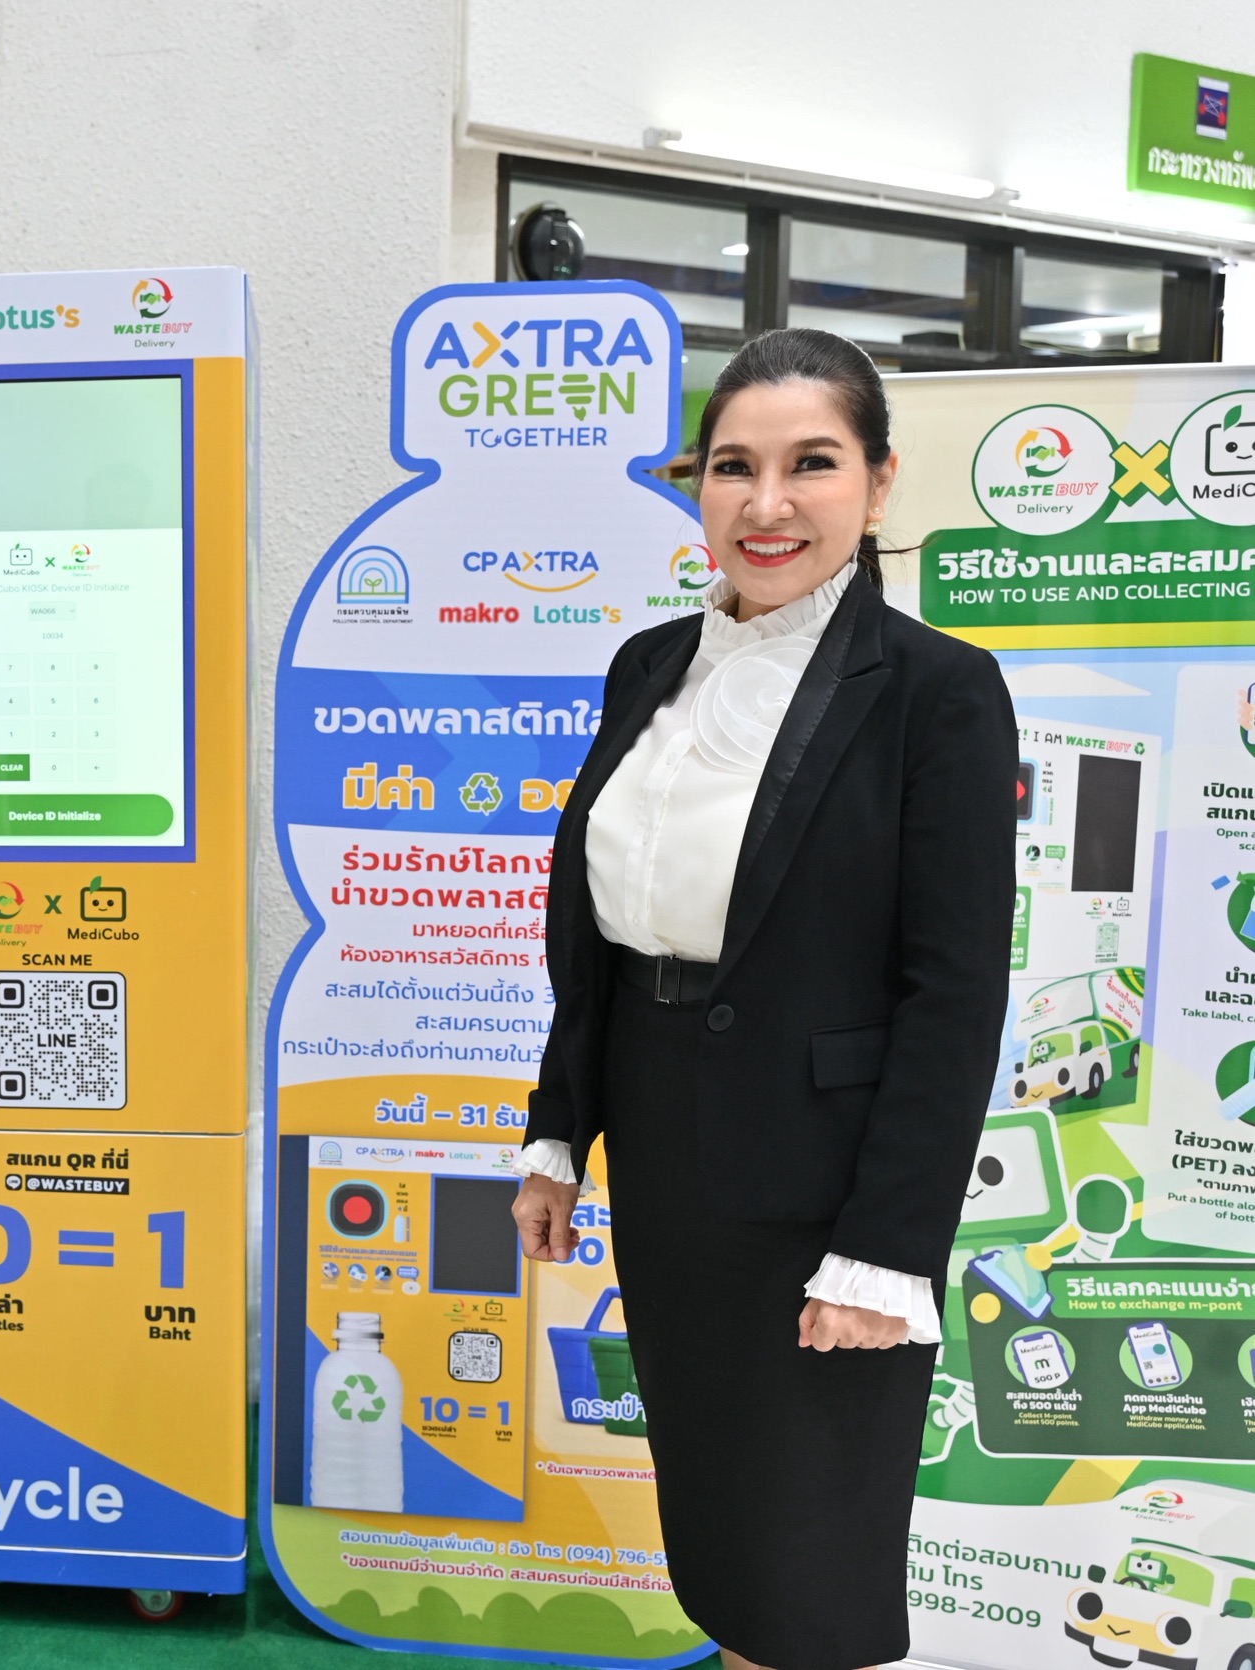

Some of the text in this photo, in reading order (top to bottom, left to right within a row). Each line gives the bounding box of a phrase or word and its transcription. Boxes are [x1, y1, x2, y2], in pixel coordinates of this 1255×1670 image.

[1148, 147, 1255, 190] กระทรวงทรัพ
[134, 339, 175, 348] Delivery
[424, 318, 653, 369] AXTRA
[438, 372, 636, 421] GREEN
[465, 427, 608, 448] TOGETHER
[1017, 503, 1073, 514] Delivery
[463, 550, 600, 572] CP AXTRA
[938, 547, 1255, 581] วิธีใช้งานและสะสมค
[22, 584, 48, 592] KIOSK
[51, 584, 80, 592] Device
[94, 583, 130, 591] Initialize
[950, 582, 1251, 605] HOW TO USE AND COLLECTING
[439, 602, 520, 623] makro
[533, 605, 622, 624] Lotus's
[1045, 733, 1062, 745] AM
[0, 763, 23, 771] CLEAR
[343, 763, 434, 809] มีค่า
[8, 810, 101, 822] Device ID Initialize
[1217, 828, 1248, 839] Open
[342, 845, 553, 873] ร่วมรักษ์โลกง่
[331, 878, 549, 909] นำขวดพลาสติ
[67, 927, 140, 941] MediCubo
[22, 954, 92, 966] SCAN ME
[340, 944, 530, 967] ห้องอาหารสวัสดิการ
[324, 975, 534, 1004] สะสมได้ตั้งแต่วันนี้ถึง
[415, 1014, 552, 1034] สะสมครบตาม
[1181, 1008, 1243, 1023] Take label,
[36, 1033, 77, 1048] LINE
[283, 1037, 546, 1063] กระเป๋าจะส่งถึงท่านภายในวั
[375, 1094, 529, 1128] วันนี้ 31 ธัน
[1175, 1129, 1255, 1154] ใส่ขวดพ
[6, 1148, 129, 1171] สแกน QR ที่นี่
[415, 1150, 444, 1158] makro
[449, 1152, 481, 1160] Lotus's
[1172, 1154, 1227, 1175] (PET)
[27, 1178, 125, 1193] @WASTEBUY
[1168, 1192, 1187, 1202] Put
[1199, 1196, 1234, 1208] bottle
[1215, 1211, 1228, 1219] of
[147, 1211, 185, 1289] 1
[1066, 1277, 1255, 1297] วิธีแลกคะแนนง่า
[144, 1305, 196, 1324] บาท
[1069, 1300, 1243, 1312] How to exchange m-pont
[148, 1326, 191, 1341] Baht
[1034, 1374, 1052, 1384] 500
[1006, 1388, 1082, 1401] สะสมยอดขั้นต่ำ
[420, 1396, 509, 1425] 10 1
[1013, 1401, 1077, 1411] ถึง 500 แต้ม
[1123, 1404, 1207, 1415] App MediCubo
[1164, 1422, 1206, 1430] application.
[1165, 1416, 1191, 1424] money
[1135, 1513, 1174, 1524] Delivery
[340, 1530, 494, 1553] สอบถามข้อมูลเพิ่มเติม
[537, 1543, 561, 1559] โทร
[567, 1546, 611, 1564] (094)
[617, 1549, 667, 1566] 796-5
[510, 1567, 672, 1592] สะสมครบก่อนมีสิทธิ์ก่อ
[942, 1564, 984, 1591] โทร
[908, 1590, 1042, 1628] 998-2009
